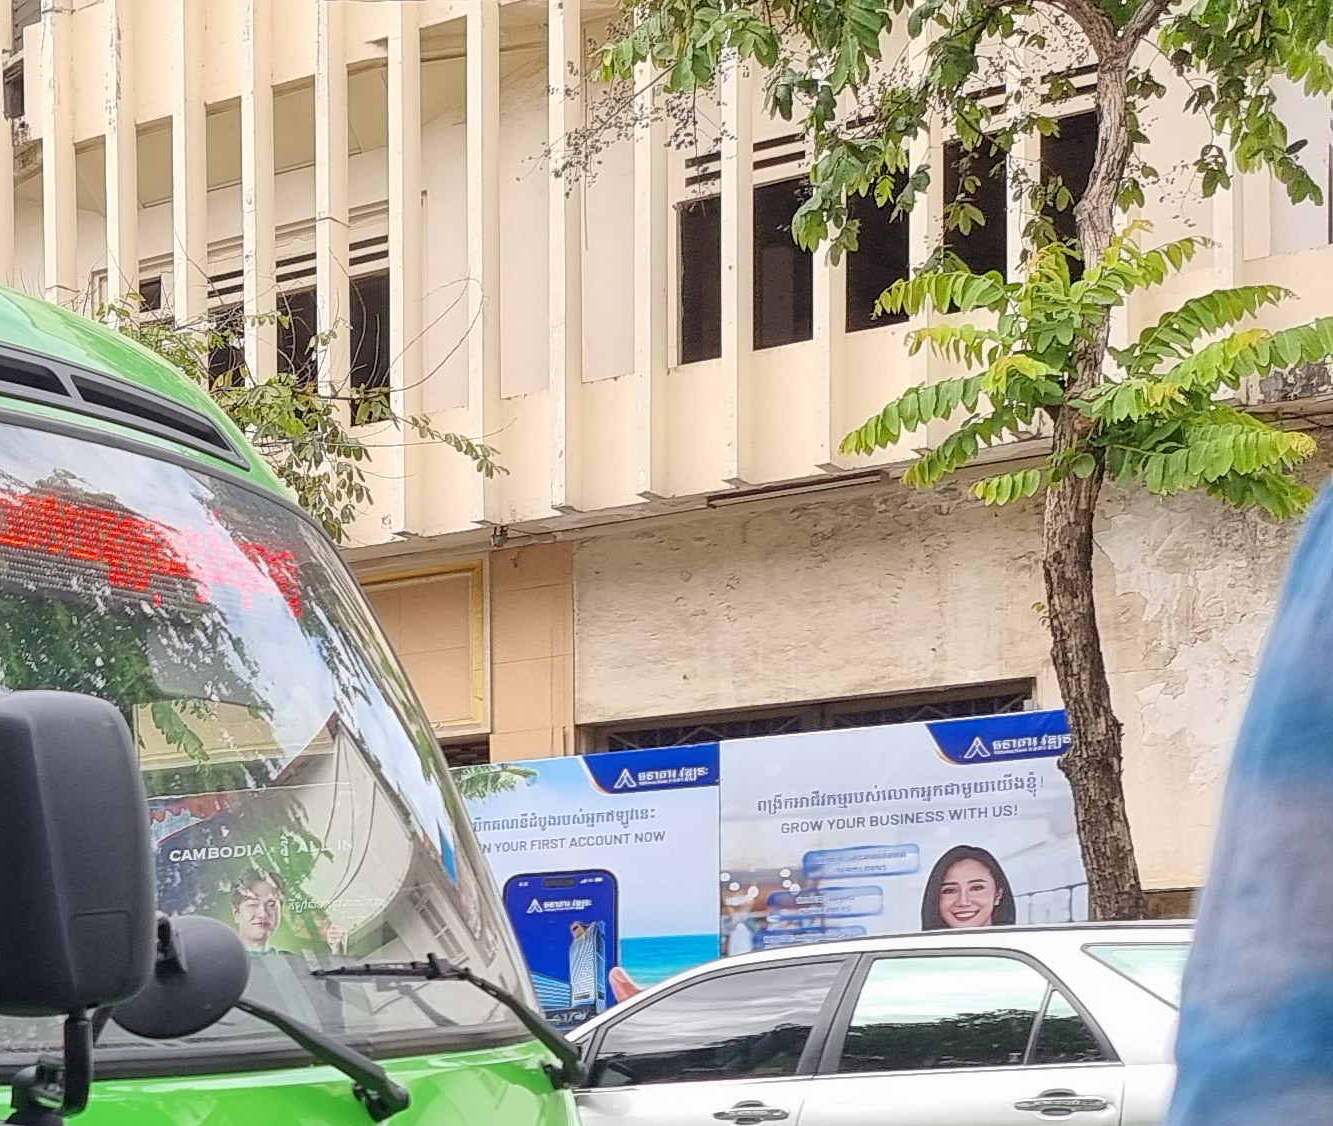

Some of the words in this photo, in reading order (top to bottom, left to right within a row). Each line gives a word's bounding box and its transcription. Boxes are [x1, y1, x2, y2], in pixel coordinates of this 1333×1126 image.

[780, 819, 823, 834] GROW
[827, 816, 866, 831] YOUR
[869, 810, 945, 827] BUSINESS
[948, 806, 988, 821] WITH
[992, 804, 1019, 817] US!
[169, 844, 264, 862] CAMBODIA
[494, 840, 528, 853] YOUR
[530, 837, 566, 851] FIRST
[568, 833, 631, 848] ACCOUNT
[635, 831, 666, 844] NOW
